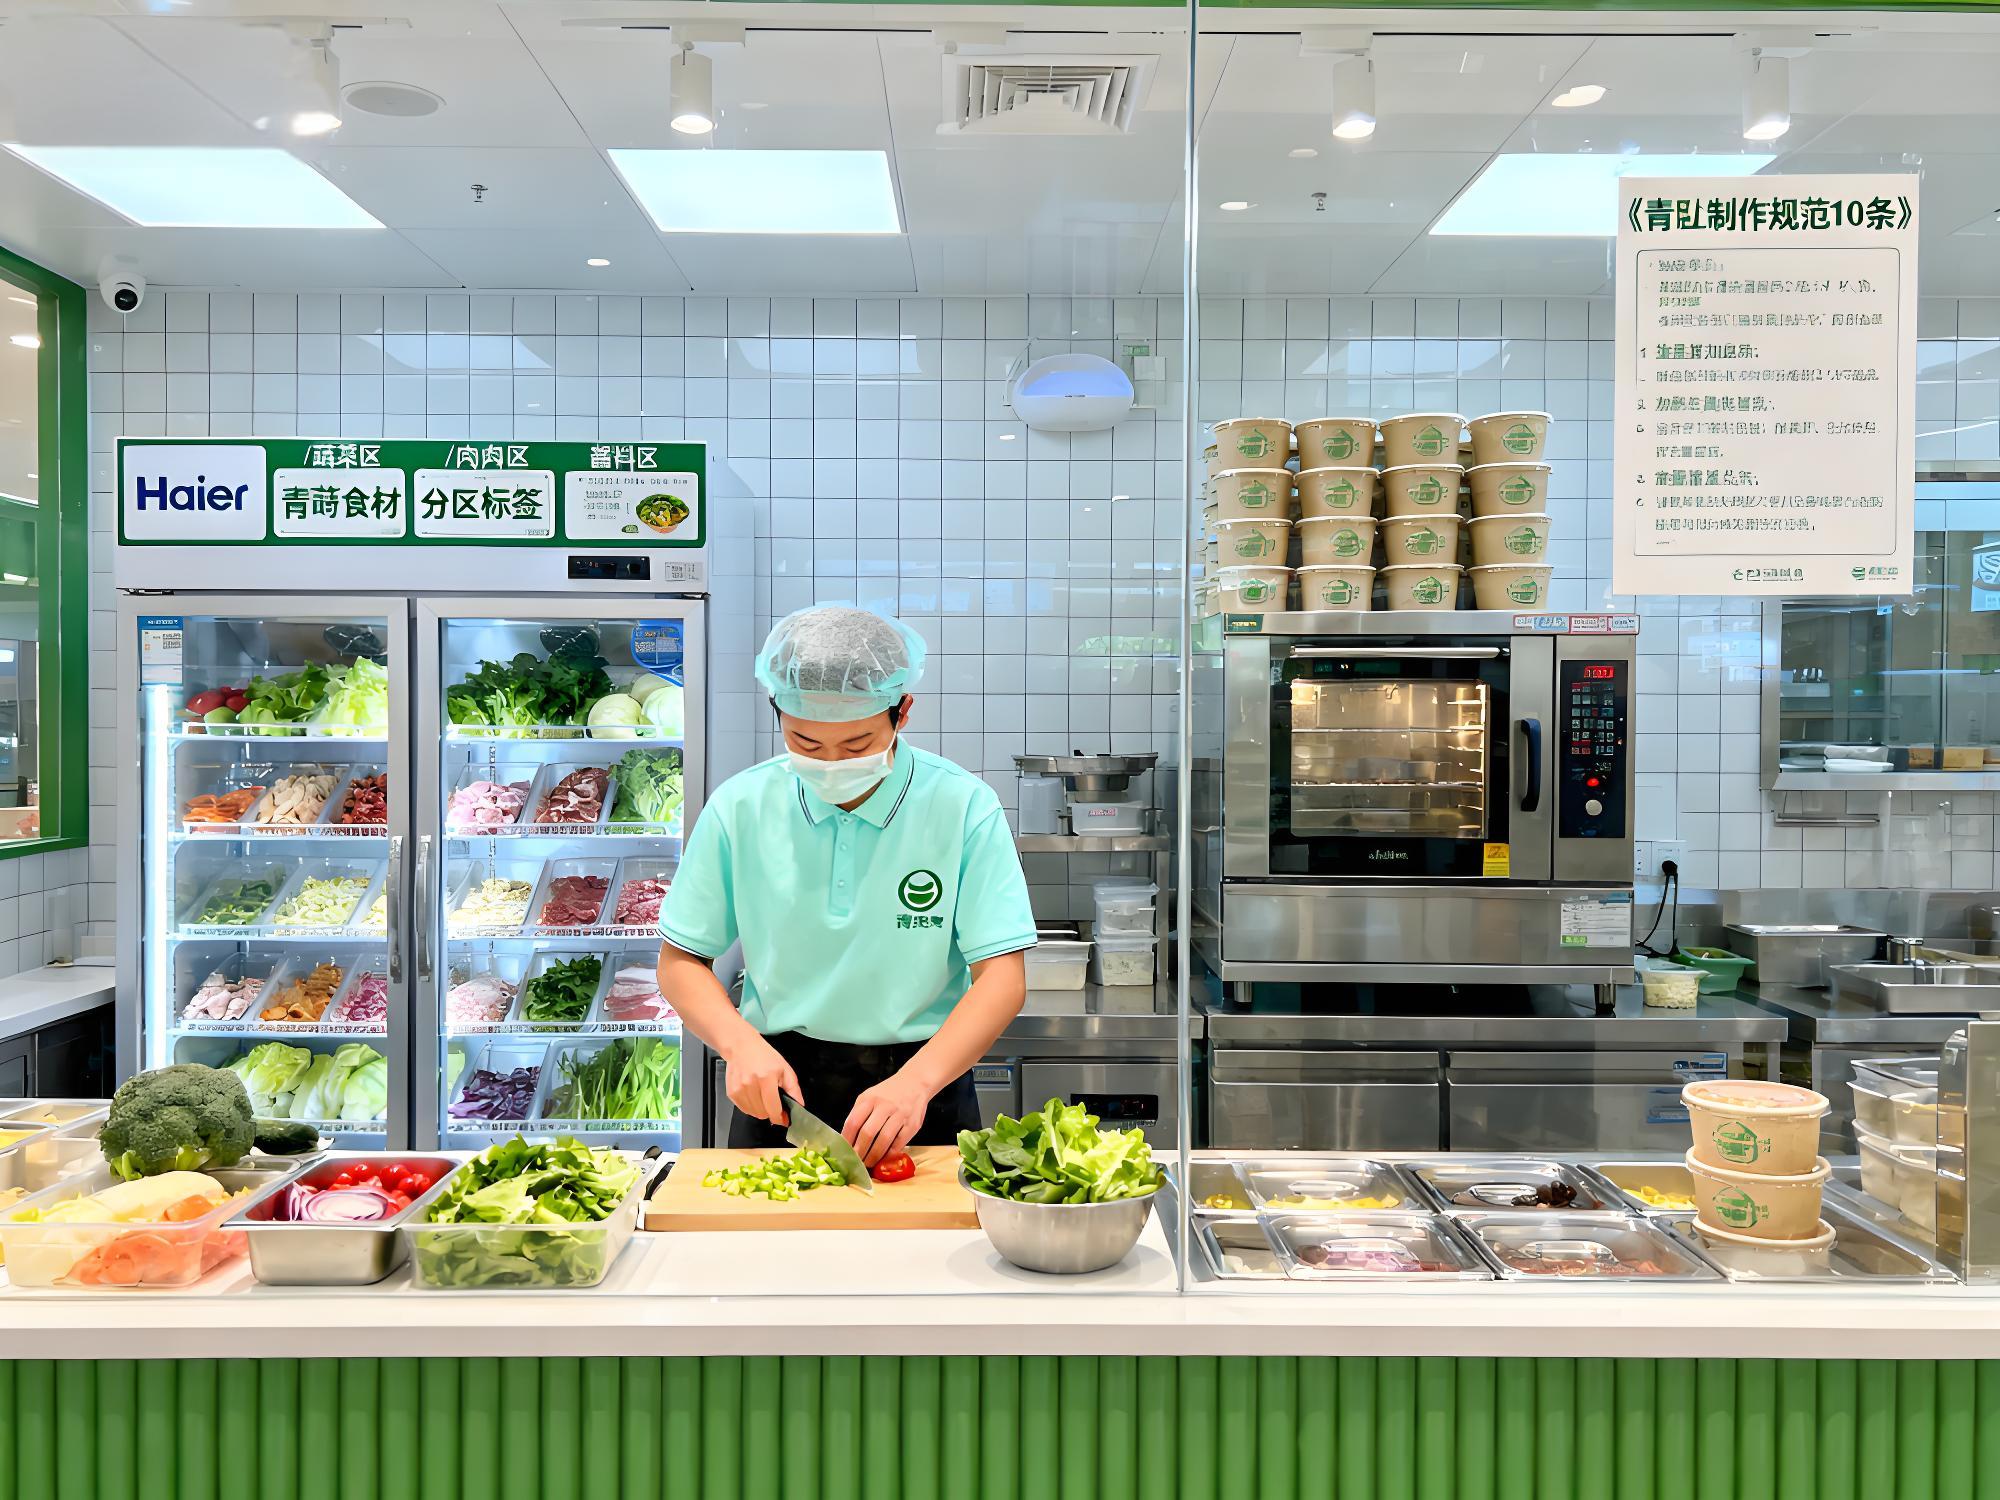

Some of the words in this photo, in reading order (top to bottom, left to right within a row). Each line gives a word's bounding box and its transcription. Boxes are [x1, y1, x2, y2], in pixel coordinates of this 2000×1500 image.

[136, 475, 249, 511] Haier
[421, 485, 543, 520] 分区标签
